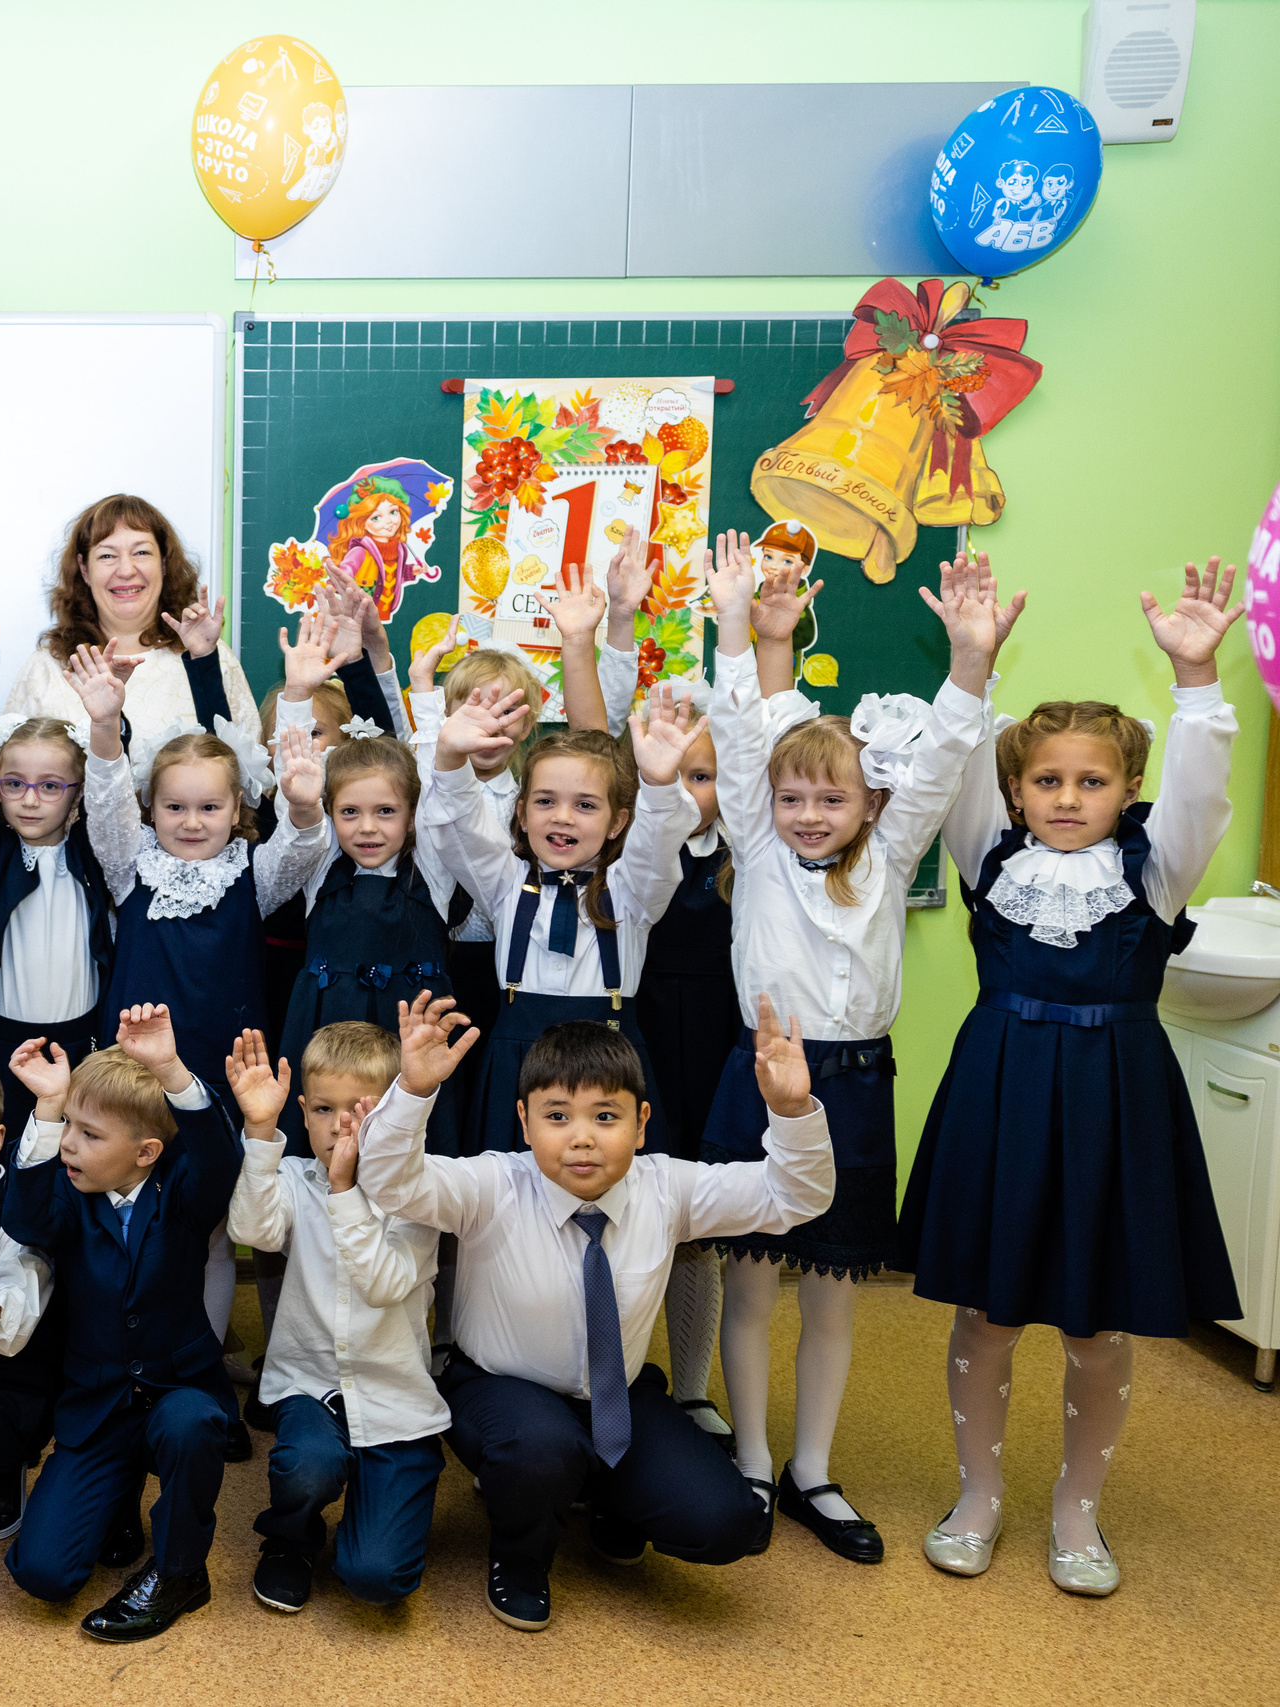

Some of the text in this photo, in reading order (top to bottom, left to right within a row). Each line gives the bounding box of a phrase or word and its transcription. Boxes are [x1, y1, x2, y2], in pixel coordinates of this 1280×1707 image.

[196, 113, 258, 151] ШКОЛА
[197, 150, 249, 183] КРУТО
[974, 218, 1058, 253] АБВ
[759, 451, 897, 523] Первый звонок
